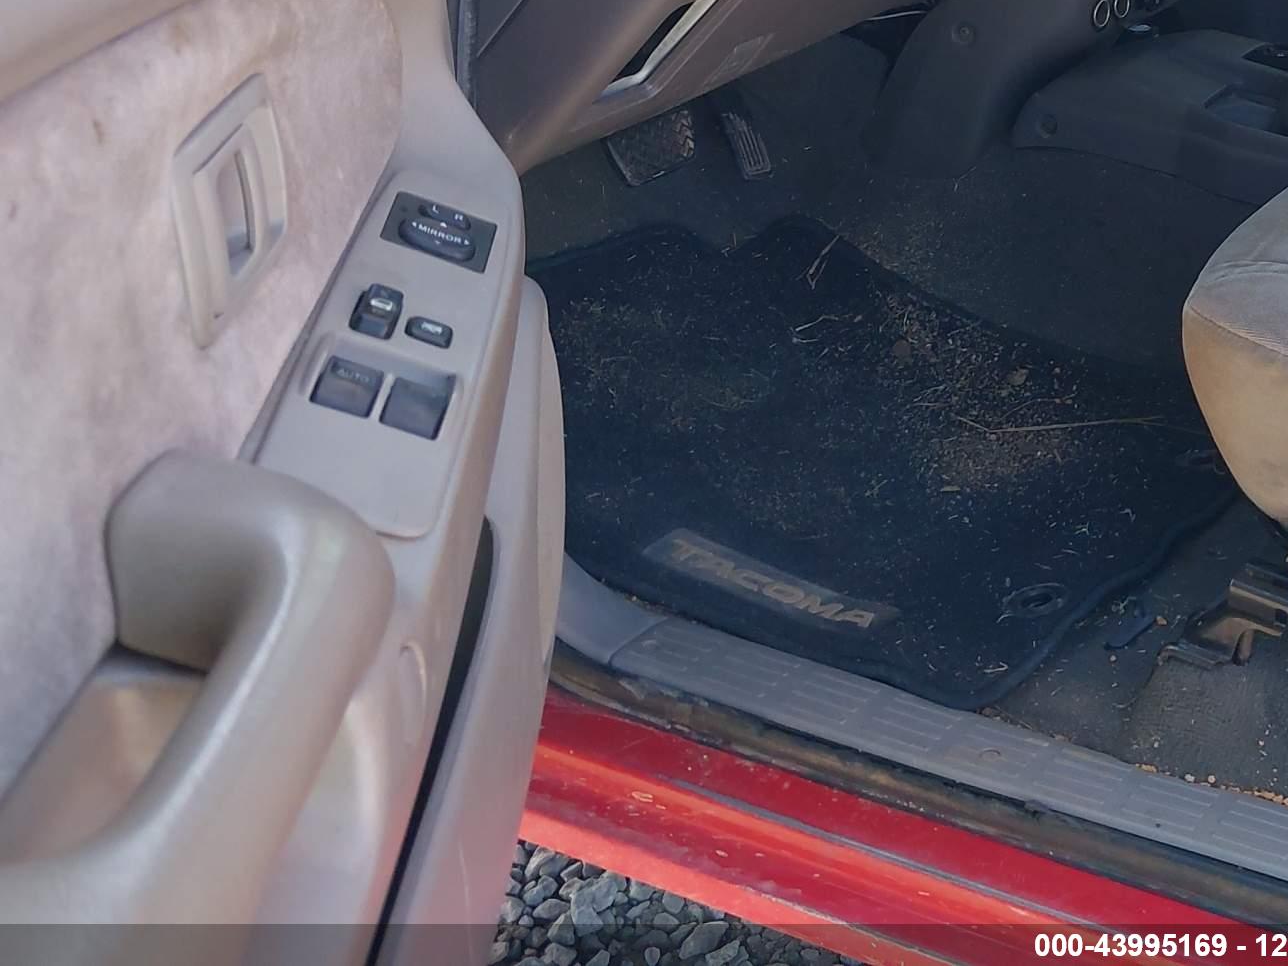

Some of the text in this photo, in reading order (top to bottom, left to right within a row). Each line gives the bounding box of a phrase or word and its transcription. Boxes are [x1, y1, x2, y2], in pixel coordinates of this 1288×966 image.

[432, 205, 440, 214] L
[418, 224, 462, 244] MIRROR
[336, 367, 370, 384] AUTO
[672, 538, 875, 628] TACOMA
